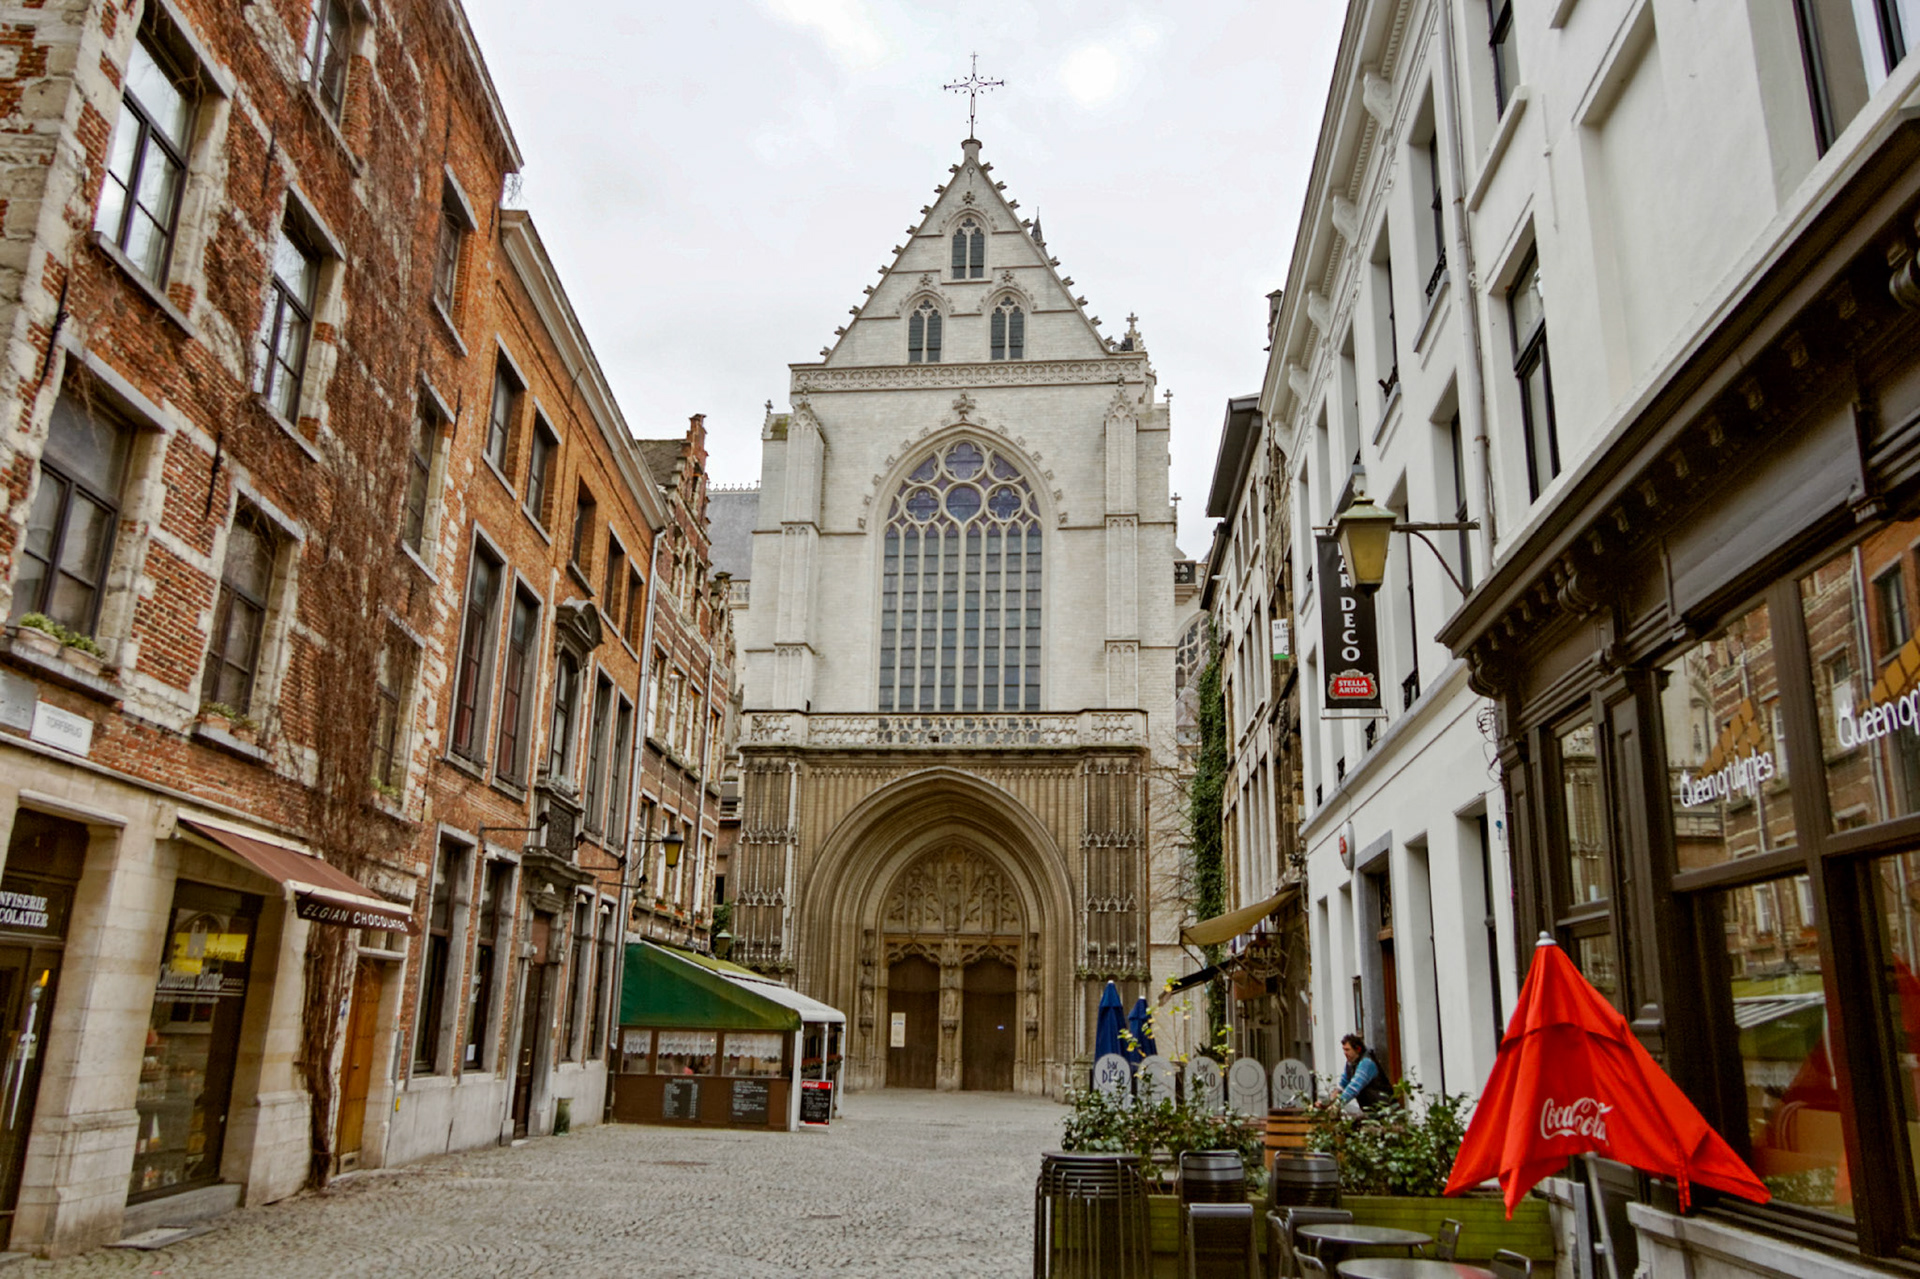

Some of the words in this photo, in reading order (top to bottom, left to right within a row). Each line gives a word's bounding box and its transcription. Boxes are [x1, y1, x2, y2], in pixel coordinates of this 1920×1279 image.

[1341, 597, 1361, 662] DECO
[1338, 679, 1368, 687] STELLA
[1339, 686, 1369, 694] ARTOIS
[1838, 701, 1899, 748] Queen
[1680, 772, 1717, 808] Queen
[1107, 1058, 1118, 1069] bar
[1285, 1062, 1297, 1074] bar
[1280, 1074, 1304, 1090] DECO
